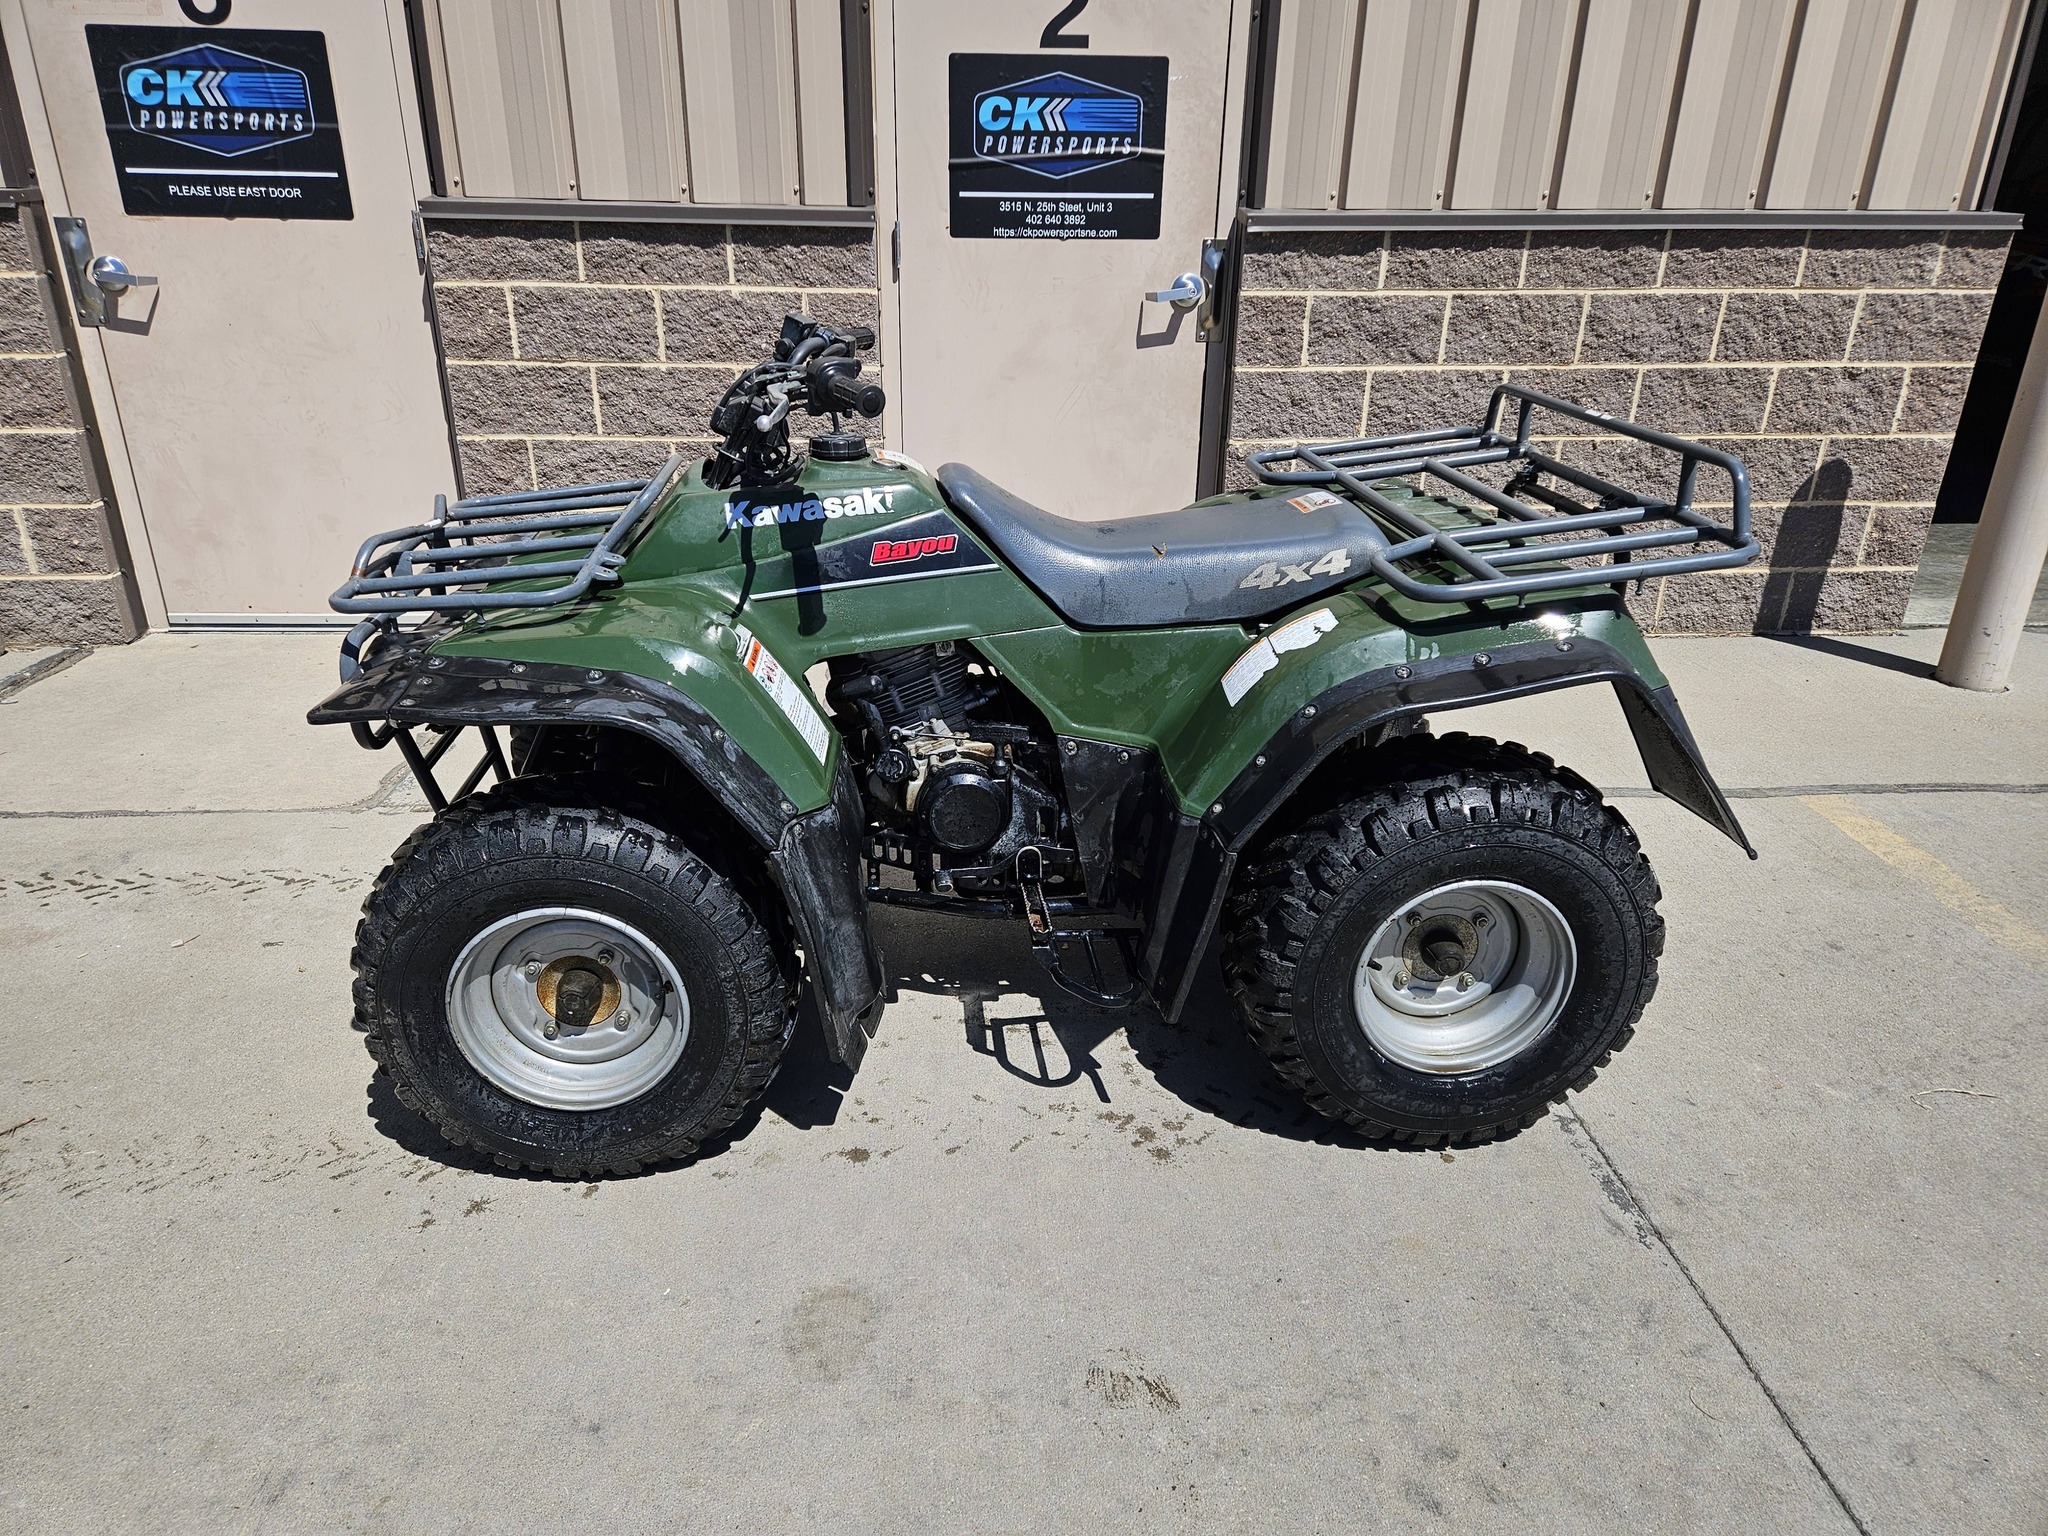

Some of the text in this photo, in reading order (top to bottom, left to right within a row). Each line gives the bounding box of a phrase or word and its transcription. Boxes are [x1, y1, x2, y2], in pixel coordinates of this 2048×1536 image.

[126, 68, 205, 107] CK
[140, 109, 304, 132] POWERSPORTS
[978, 95, 1052, 132] CK
[983, 135, 1133, 155] POWERSPORTS
[168, 185, 302, 198] PLEASE USE EAST DOOR
[999, 201, 1113, 213] 3515 N. 25th Steet, Unit 3
[1025, 214, 1086, 225] 402 640 3892
[993, 226, 1118, 239] https://ckpowersportsne.com
[724, 485, 895, 530] Kawasaki
[870, 533, 959, 567] Bayou
[1238, 547, 1352, 590] 4x4
